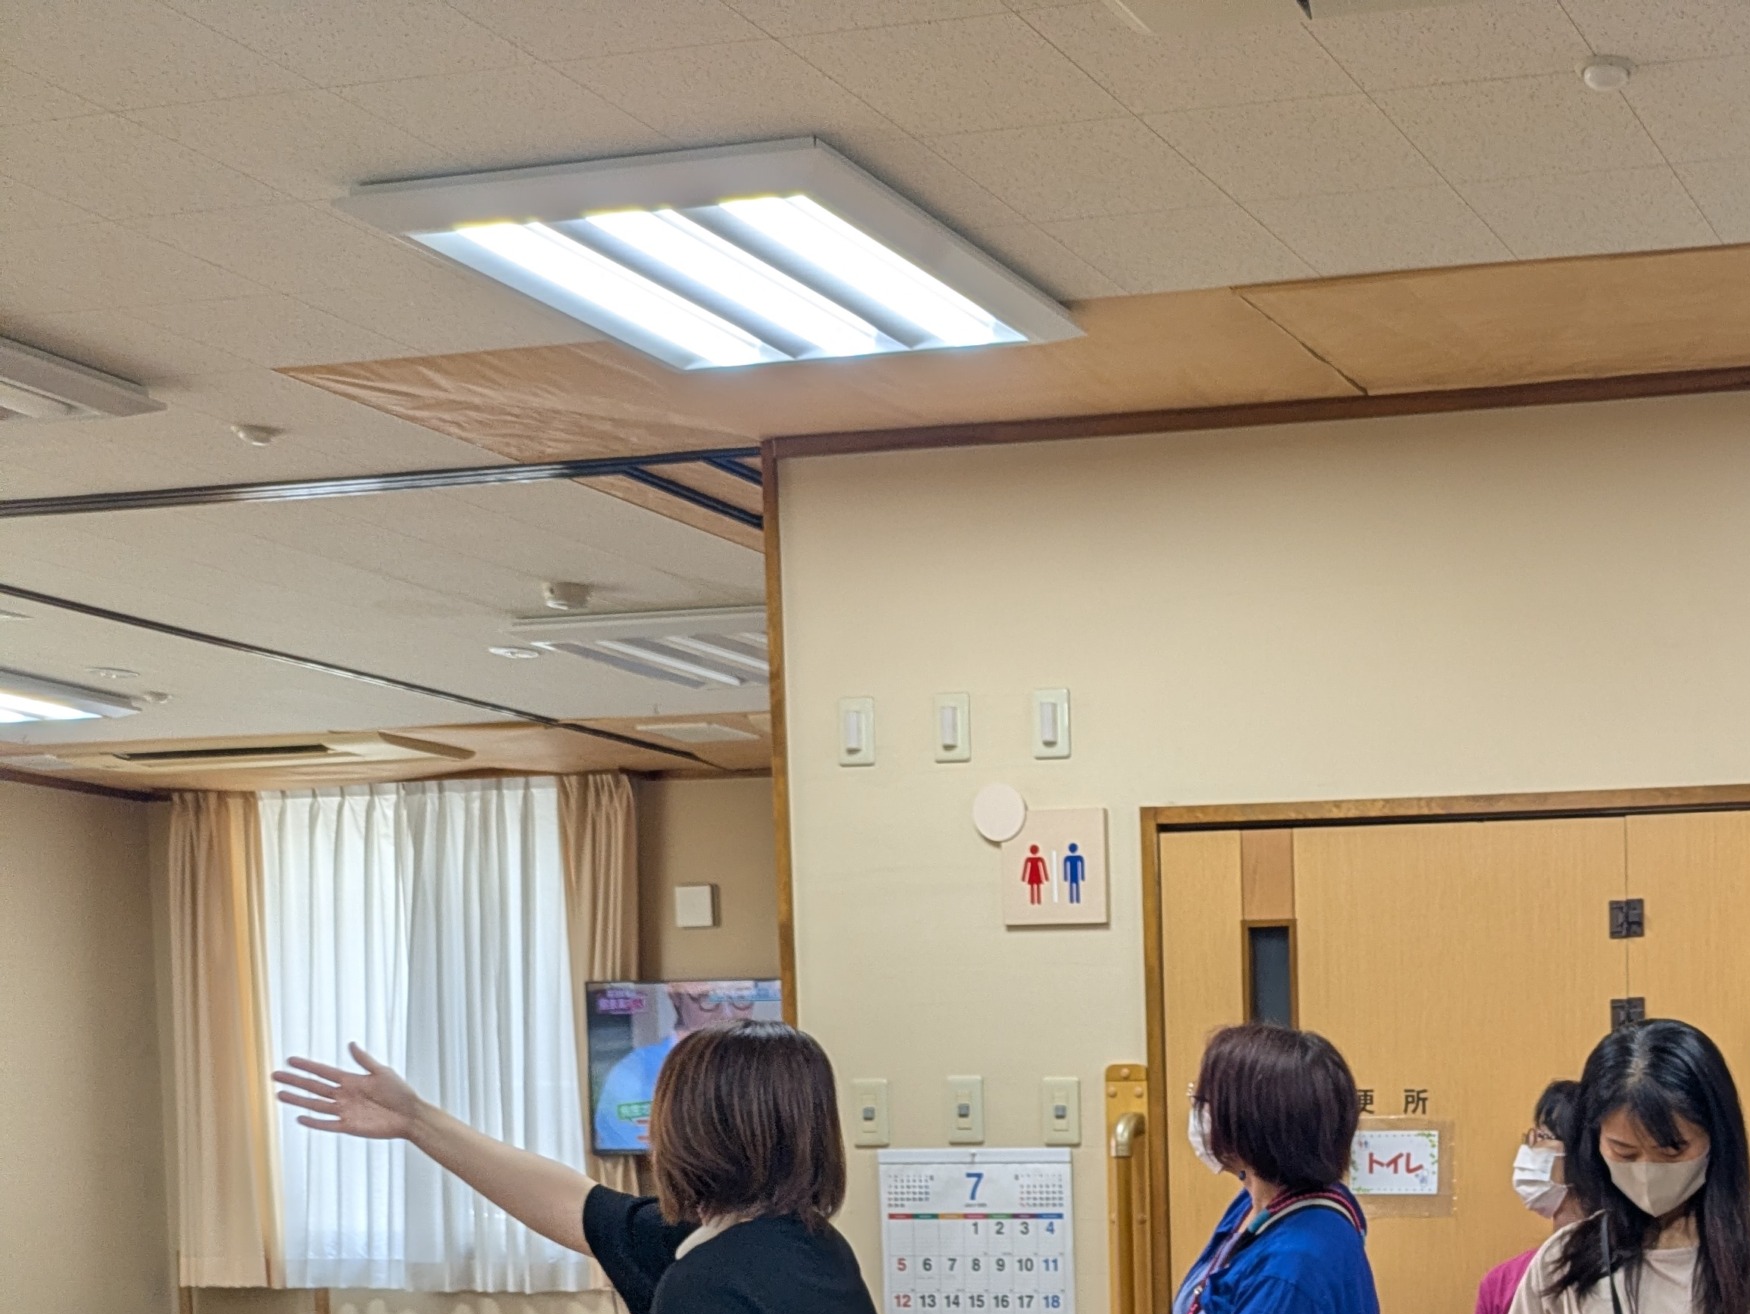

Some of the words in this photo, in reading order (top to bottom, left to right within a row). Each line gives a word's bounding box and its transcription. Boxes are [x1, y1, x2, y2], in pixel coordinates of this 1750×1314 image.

[1368, 1152, 1424, 1175] トイレ
[965, 1172, 984, 1201] 7
[971, 1221, 979, 1235] 1
[995, 1220, 1005, 1236] 2
[1019, 1220, 1030, 1236] 3
[1045, 1220, 1055, 1235] 4
[897, 1257, 907, 1272] 5
[922, 1257, 933, 1272] 6
[947, 1257, 958, 1272] 7
[971, 1257, 981, 1272] 8
[995, 1257, 1006, 1272] 9
[1016, 1257, 1035, 1272] 10
[1042, 1257, 1059, 1272] 11
[894, 1293, 912, 1308] 12
[918, 1293, 937, 1309] 13
[944, 1294, 961, 1308] 14
[968, 1294, 985, 1309] 15
[992, 1294, 1010, 1309] 16
[1017, 1294, 1035, 1309] 17
[1042, 1294, 1061, 1309] 18
